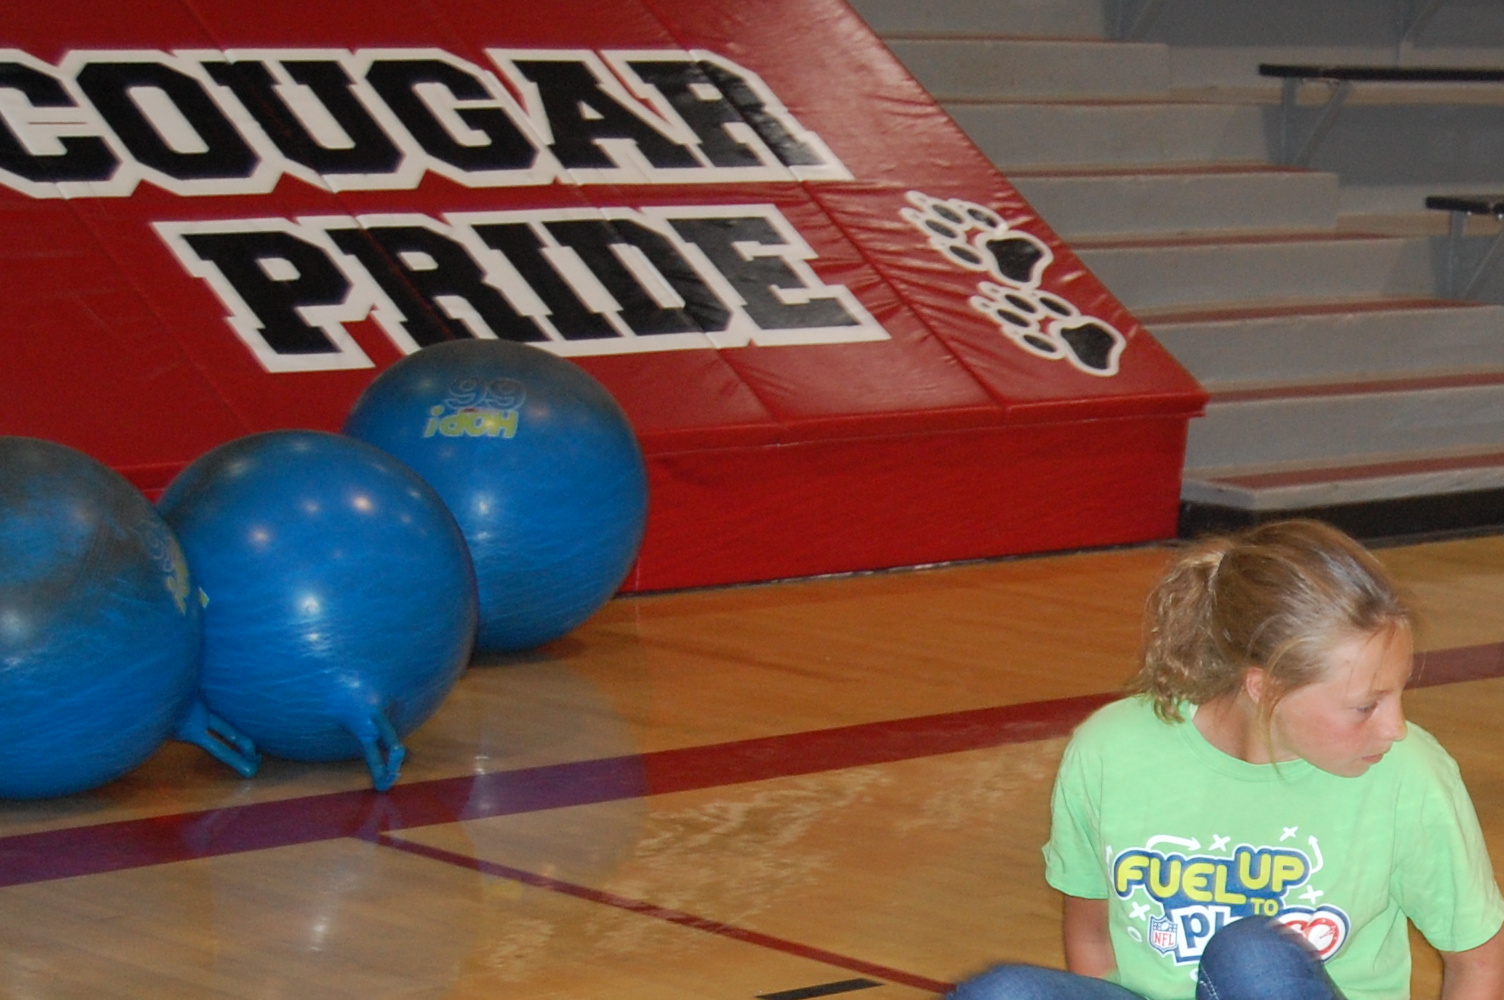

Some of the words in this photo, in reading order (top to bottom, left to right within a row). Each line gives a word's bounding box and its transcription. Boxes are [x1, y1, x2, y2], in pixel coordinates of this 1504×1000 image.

[0, 50, 854, 198] COUGAR
[153, 205, 890, 370] PRIDE
[1117, 855, 1247, 905] FUEL
[1238, 851, 1305, 893] UP
[1250, 897, 1279, 917] TO
[1154, 931, 1175, 947] NFL
